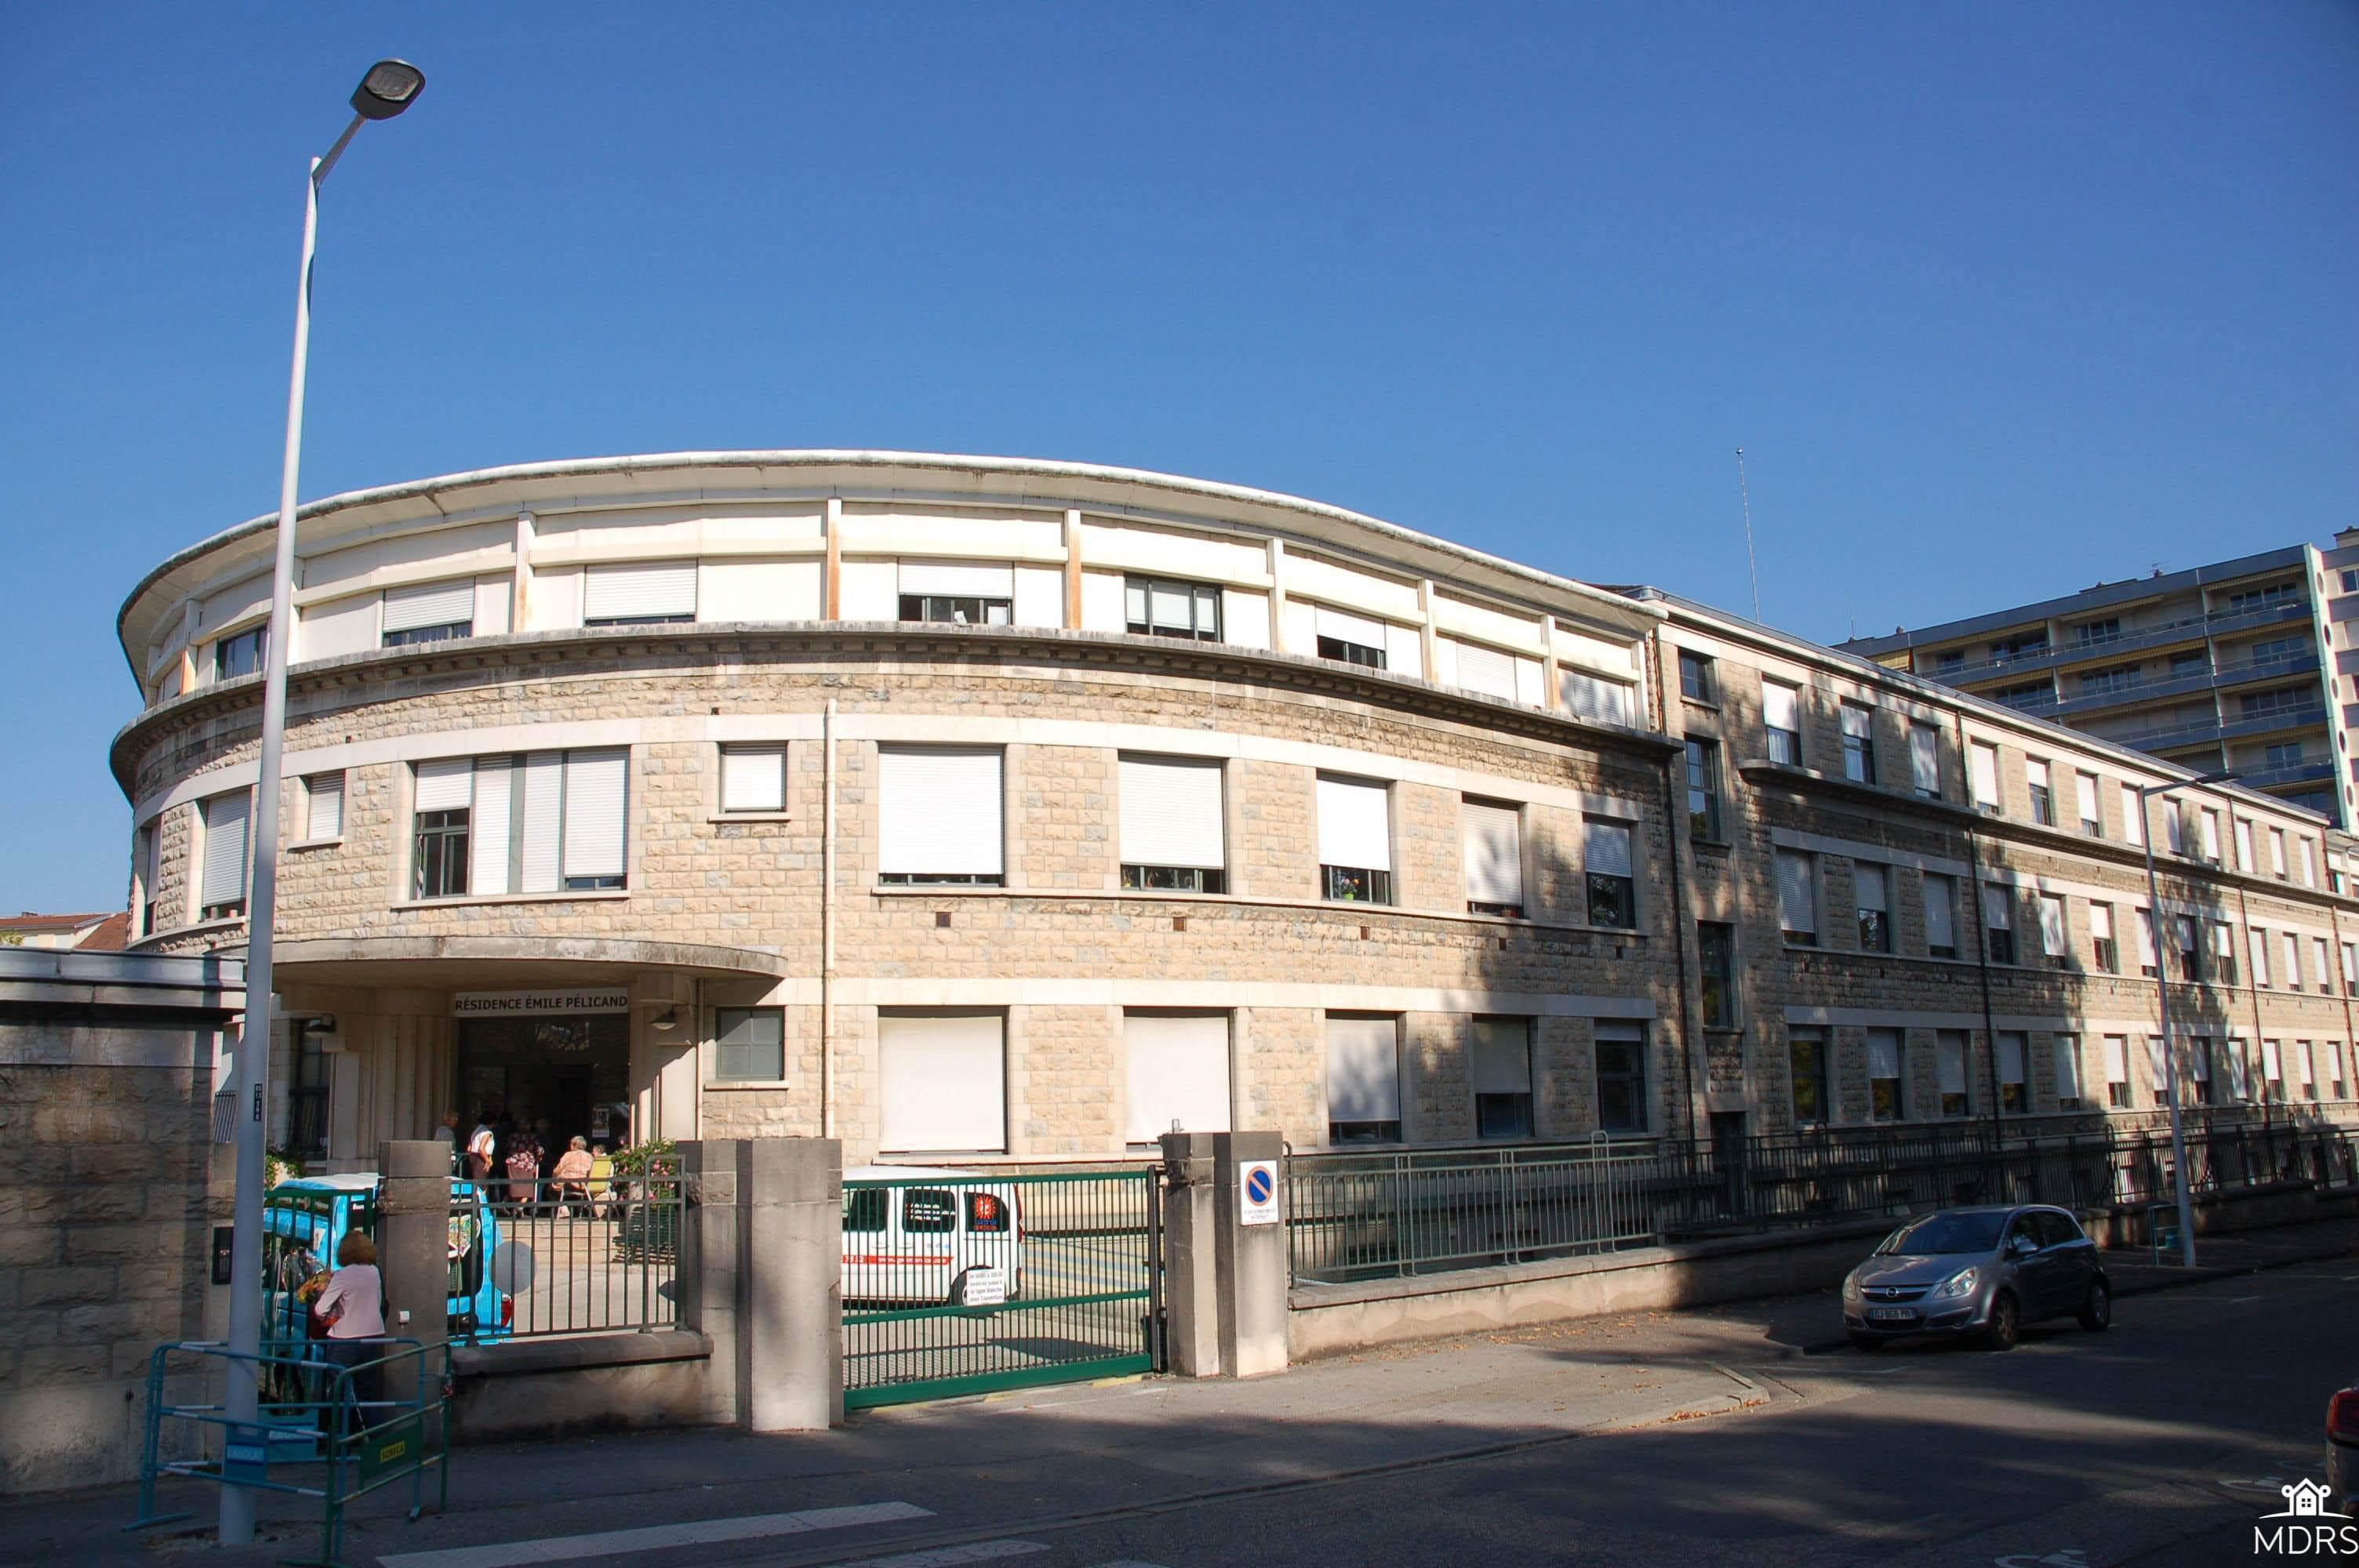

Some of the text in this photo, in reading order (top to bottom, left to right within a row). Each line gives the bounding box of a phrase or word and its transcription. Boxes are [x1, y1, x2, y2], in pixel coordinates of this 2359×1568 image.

[455, 993, 627, 1011] RÉSIDENCE ÉMILE PÉLICAND
[382, 1442, 404, 1461] SOBECA
